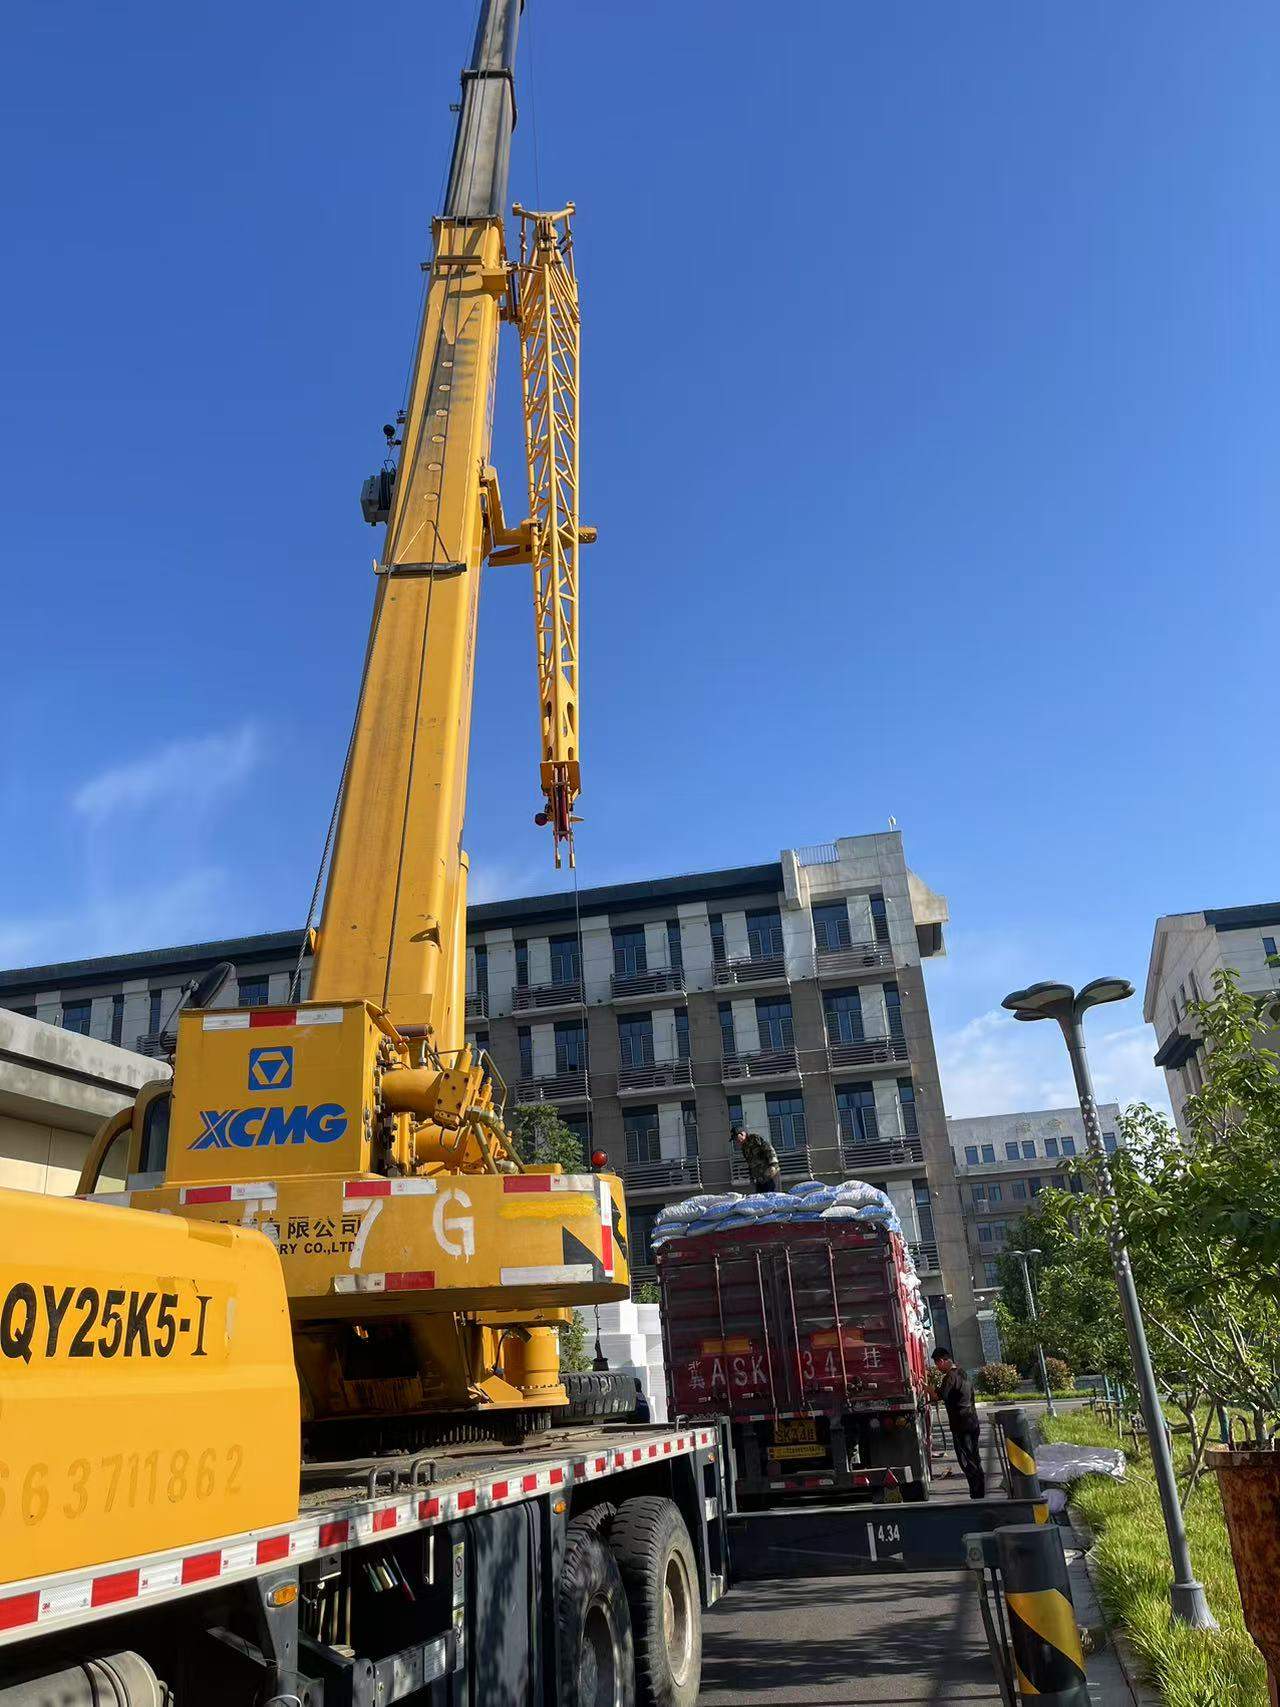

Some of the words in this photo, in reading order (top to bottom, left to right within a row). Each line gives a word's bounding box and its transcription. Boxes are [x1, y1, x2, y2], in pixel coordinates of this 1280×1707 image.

[187, 1103, 348, 1150] XCMG
[277, 1243, 297, 1255] RY
[878, 1524, 900, 1541] 4.34
